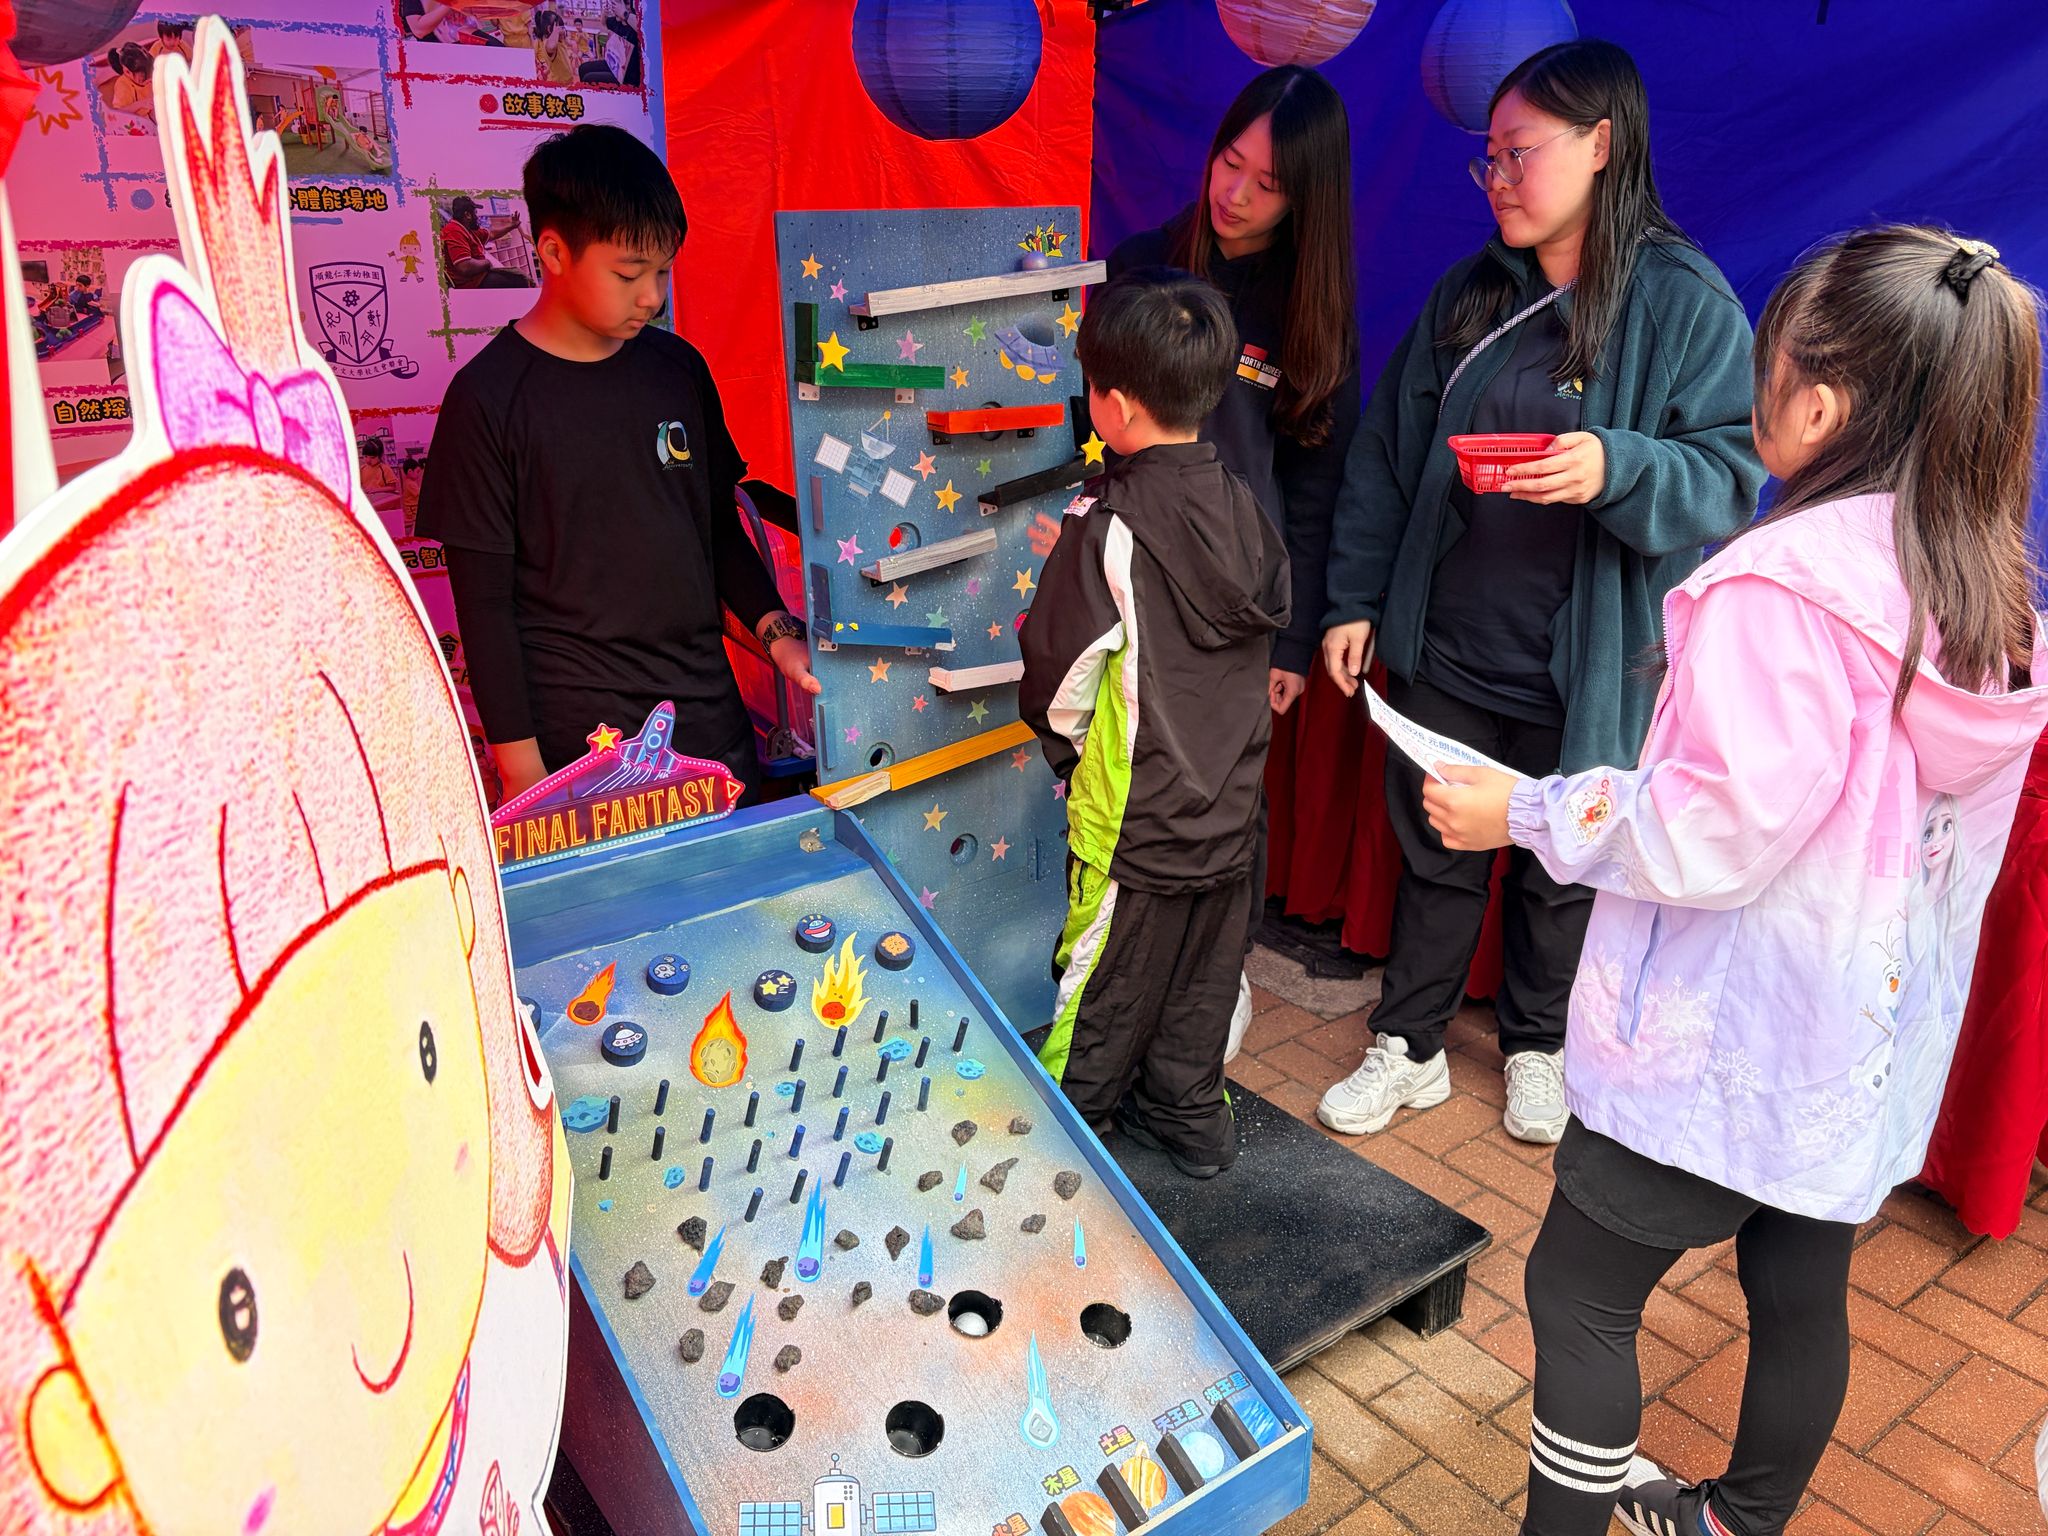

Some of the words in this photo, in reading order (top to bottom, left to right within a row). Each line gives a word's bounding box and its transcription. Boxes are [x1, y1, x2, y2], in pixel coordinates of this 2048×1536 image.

[502, 92, 584, 120] 故事教學
[1240, 354, 1260, 370] NORTH
[1261, 363, 1283, 378] SHORES
[53, 396, 132, 424] 自然探
[400, 547, 449, 569] 元智
[494, 809, 587, 865] FINAL
[592, 776, 716, 841] FANTASY
[1202, 1371, 1250, 1405] 海王星
[1152, 1399, 1203, 1434] 天王星
[1098, 1424, 1136, 1457] 土星
[1041, 1465, 1083, 1497] 木星
